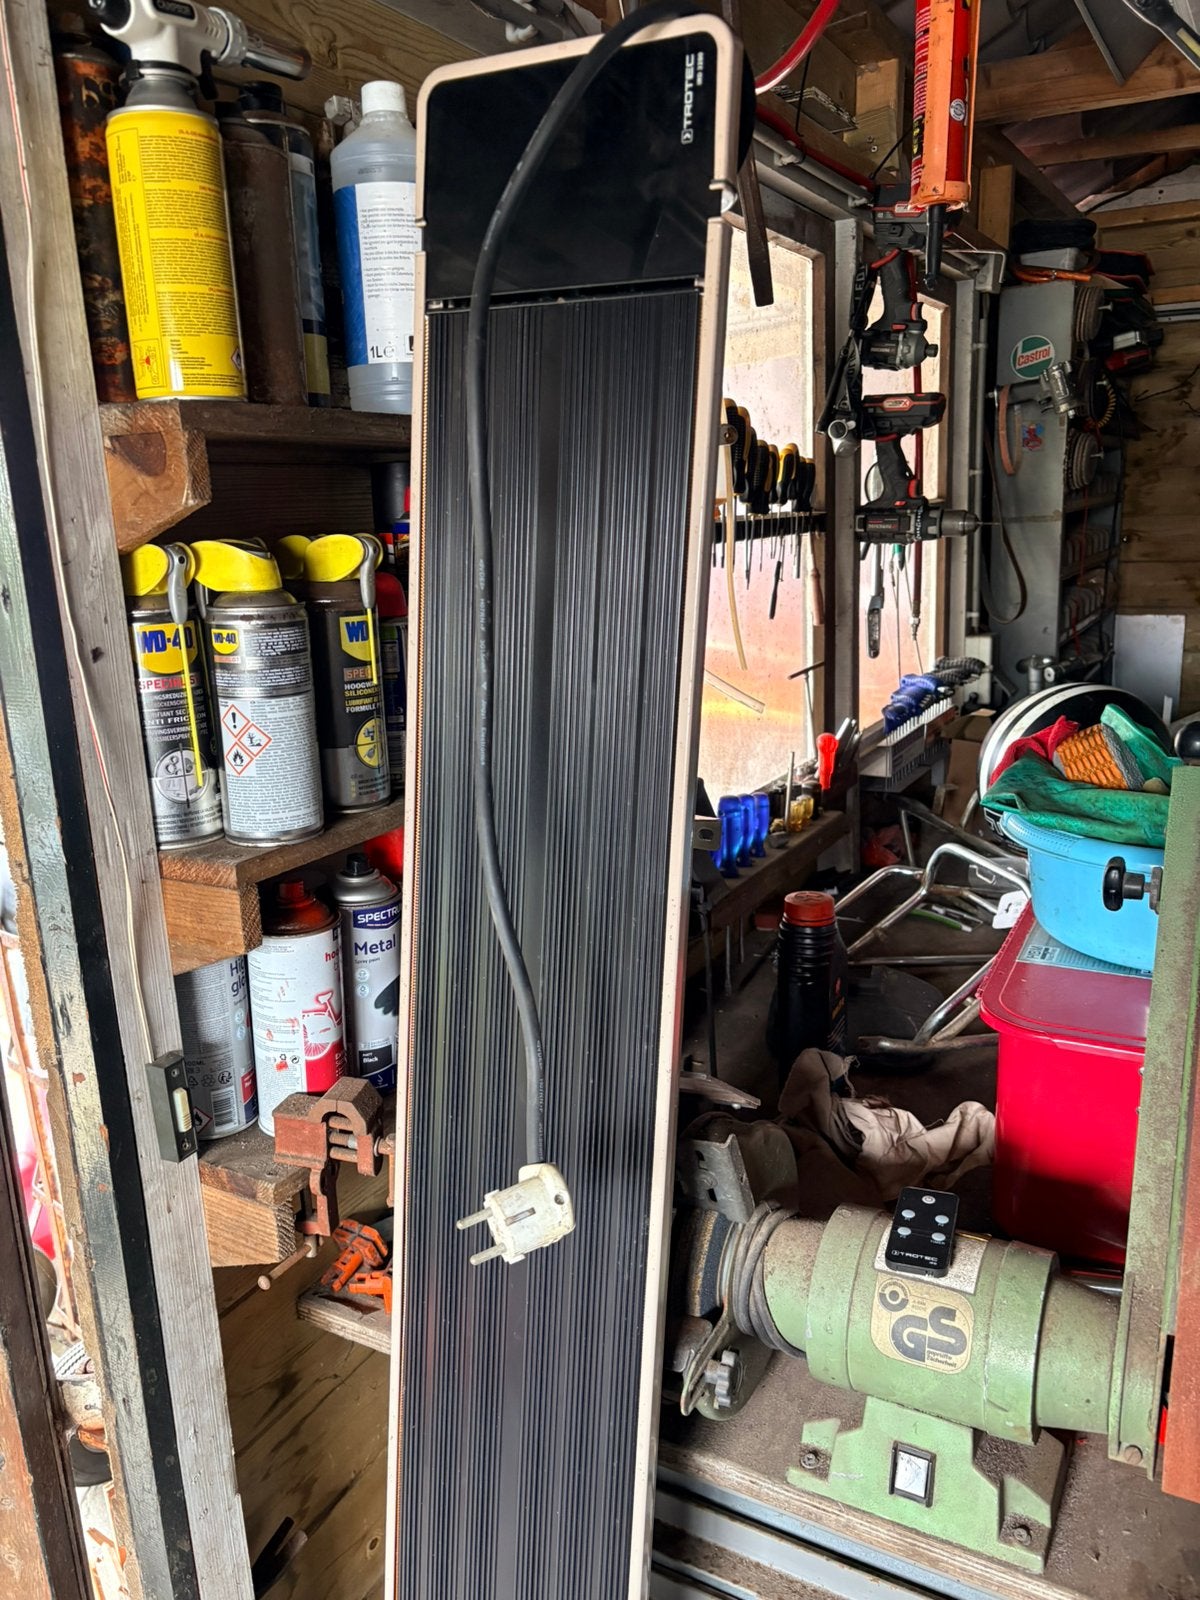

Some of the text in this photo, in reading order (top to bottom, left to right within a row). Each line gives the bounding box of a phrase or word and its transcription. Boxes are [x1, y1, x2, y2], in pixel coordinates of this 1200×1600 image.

[683, 53, 695, 130] TROTEC
[1017, 346, 1051, 367] Castrol
[213, 632, 237, 644] WD-40
[357, 905, 400, 924] SPECTR
[354, 933, 396, 956] Metal
[900, 1251, 938, 1262] TROTEC
[891, 1306, 967, 1362] GS
